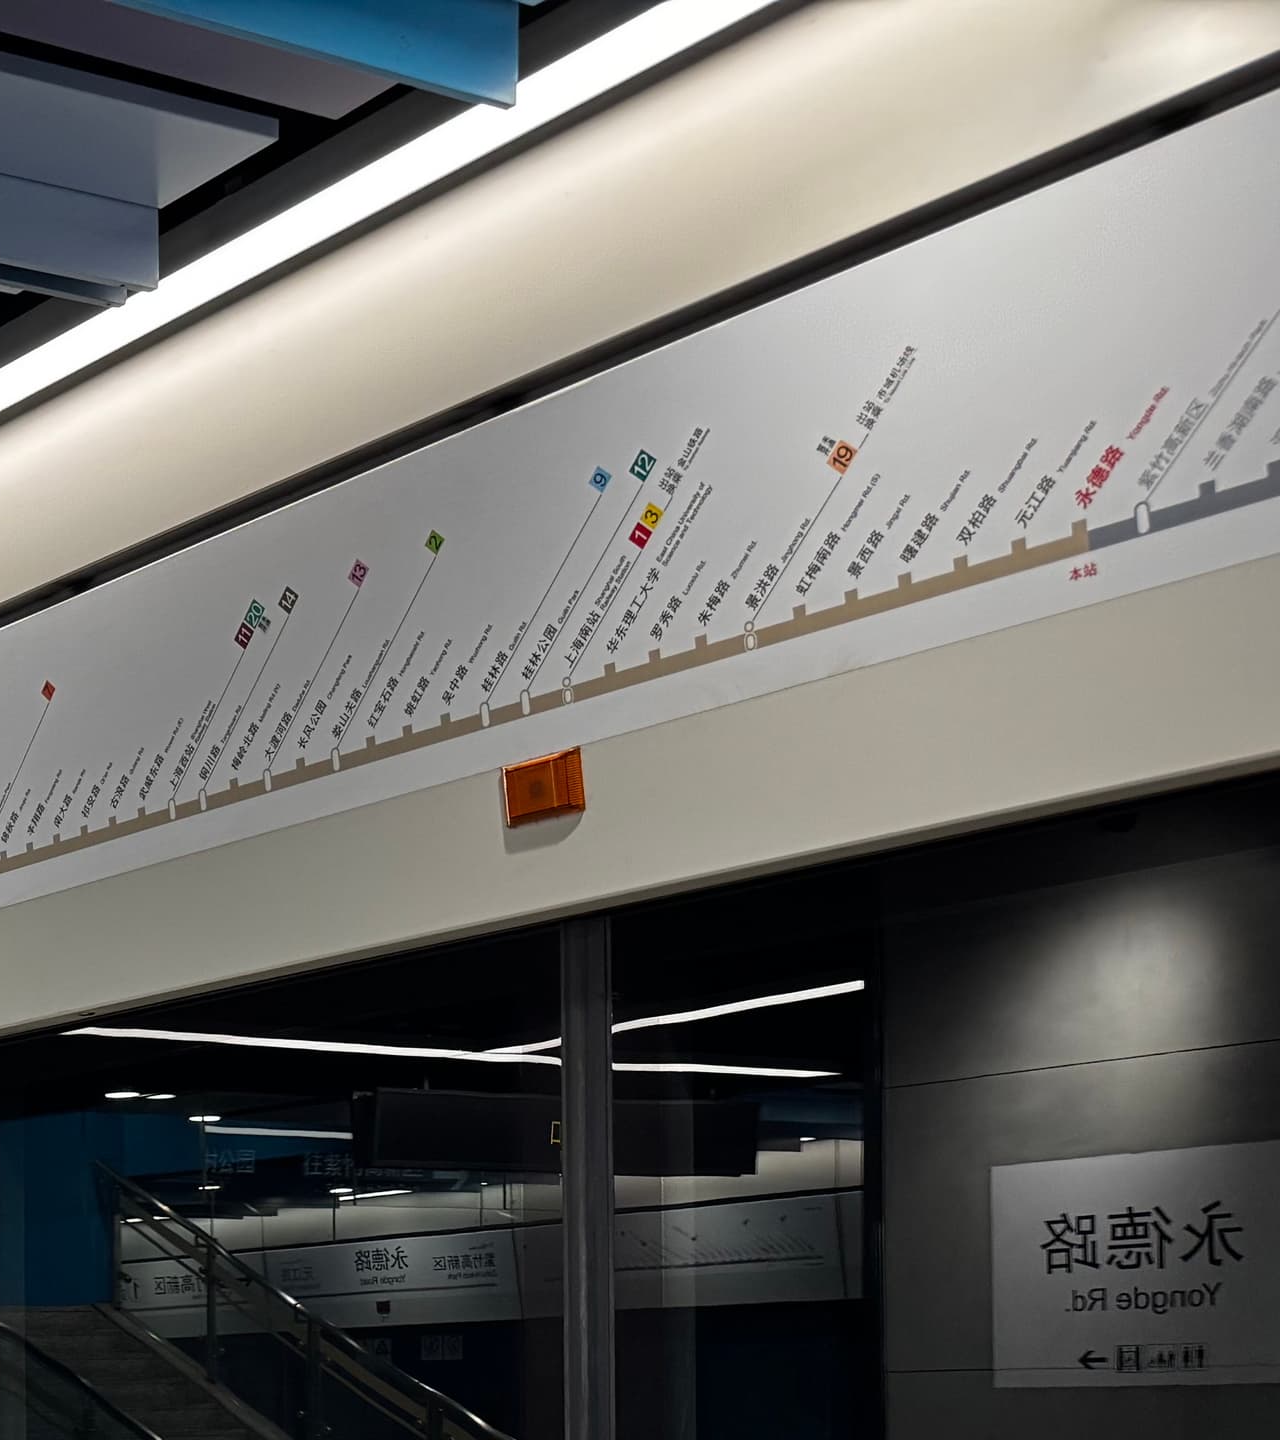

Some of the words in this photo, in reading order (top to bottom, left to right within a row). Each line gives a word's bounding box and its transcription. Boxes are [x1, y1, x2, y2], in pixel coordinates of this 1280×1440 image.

[592, 473, 608, 488] 9
[632, 453, 654, 478] 12
[831, 445, 854, 469] 19
[1074, 445, 1125, 509] 永德路
[644, 508, 660, 524] 3
[955, 493, 997, 547] 双柏路
[1014, 474, 1056, 529] 元江路
[429, 534, 442, 550] 2
[846, 529, 884, 579] 景西路
[899, 512, 939, 564] 曙建路
[351, 563, 366, 582] 13
[744, 563, 779, 612] 景洪路
[795, 531, 841, 597] 虹梅南路
[1068, 562, 1098, 582] 本站
[236, 627, 252, 646] 11
[247, 602, 263, 626] 20
[280, 591, 295, 609] 14
[606, 567, 661, 654] 华东理工大学
[650, 595, 682, 641] 罗秀路
[697, 579, 730, 627] 朱梅路
[521, 623, 558, 680] 桂林公园
[564, 610, 601, 669] 上海南站
[441, 664, 468, 706] 吴中路
[481, 650, 508, 693] 桂林路
[331, 687, 362, 740] 娄山关路
[367, 675, 399, 728] 红宝石路
[404, 676, 430, 718] 姚虹路
[264, 711, 292, 761] 大渡河路
[298, 700, 327, 750] 长风公园
[170, 743, 195, 791] 上海西站
